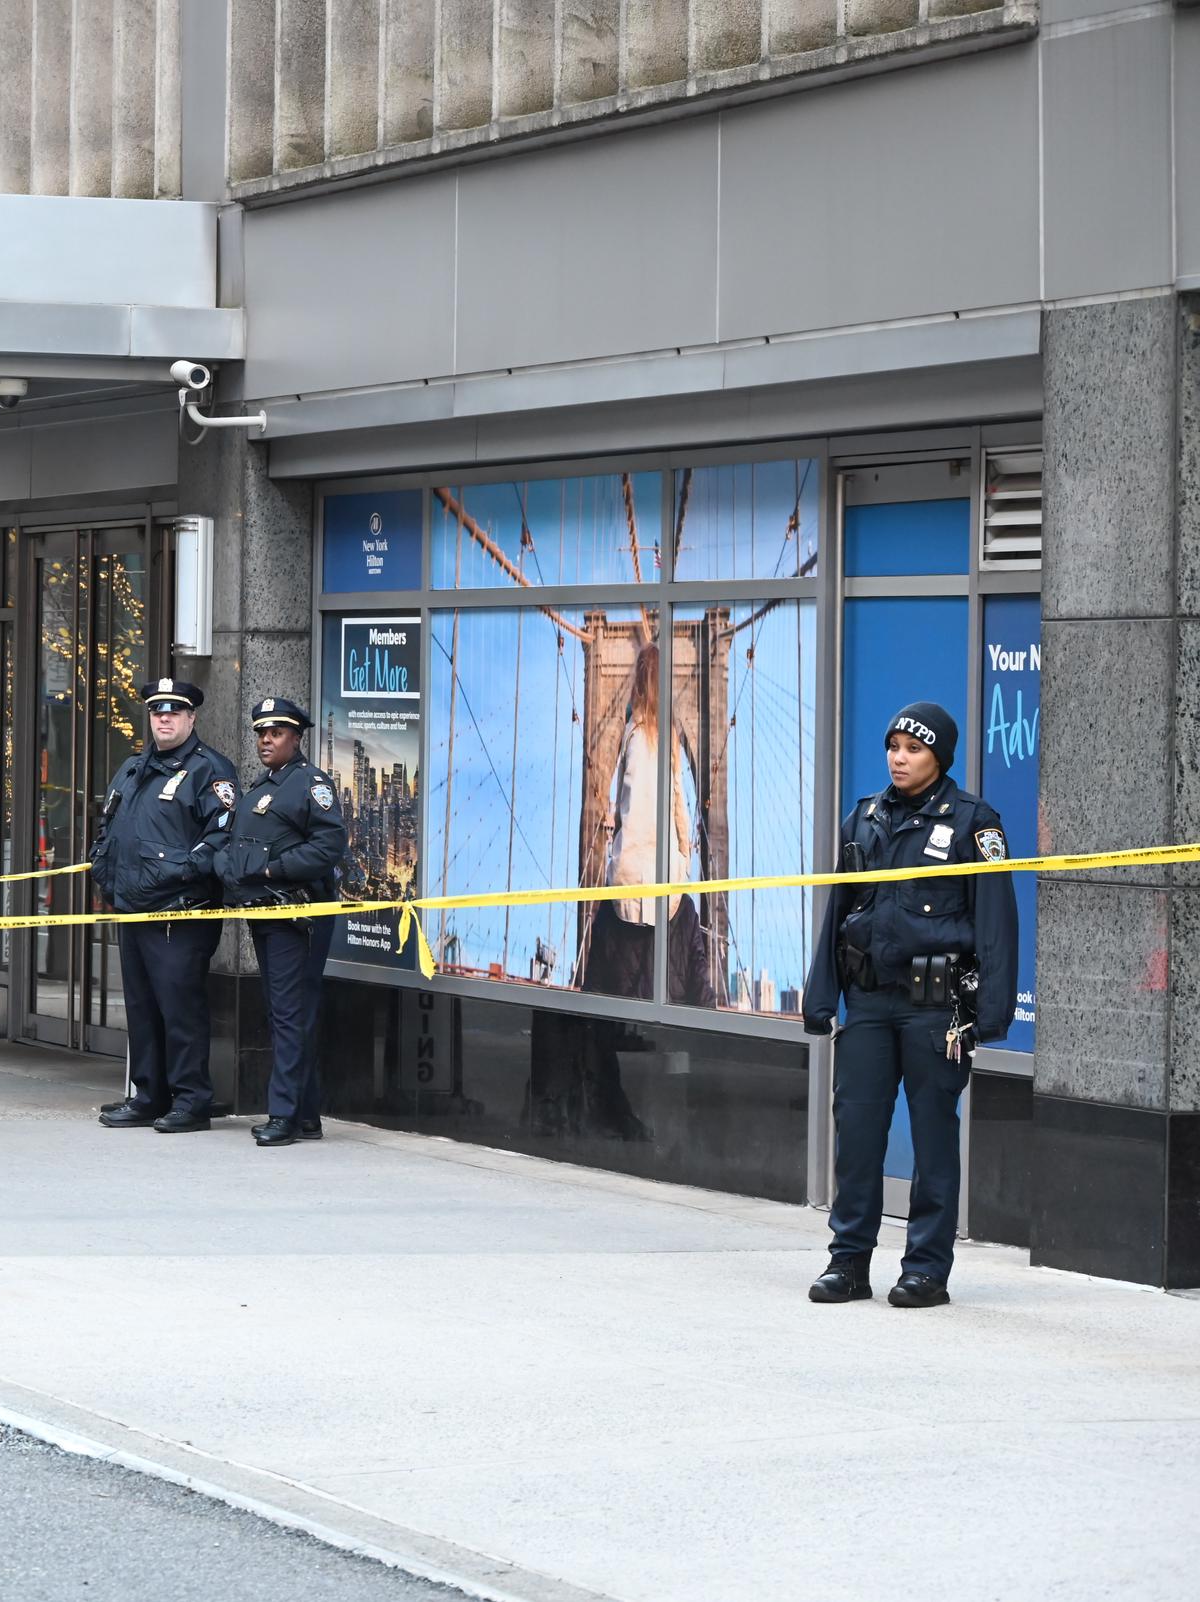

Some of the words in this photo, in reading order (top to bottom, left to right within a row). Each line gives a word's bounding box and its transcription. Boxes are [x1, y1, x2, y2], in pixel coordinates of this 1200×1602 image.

[362, 540, 375, 552] New
[375, 539, 388, 551] York
[367, 555, 383, 567] Hilton
[369, 628, 406, 645] Members
[988, 644, 1026, 671] Your
[349, 647, 371, 694] Get
[375, 648, 408, 694] More
[356, 710, 373, 718] exclusive
[398, 722, 407, 730] food
[895, 717, 936, 745] NYPD
[348, 920, 360, 931] Book
[361, 923, 371, 932] now
[372, 924, 382, 934] with
[383, 925, 391, 935] the
[347, 934, 362, 945] Hilton
[362, 936, 380, 948] Honors
[380, 938, 391, 951] App
[1017, 990, 1032, 1003] ook
